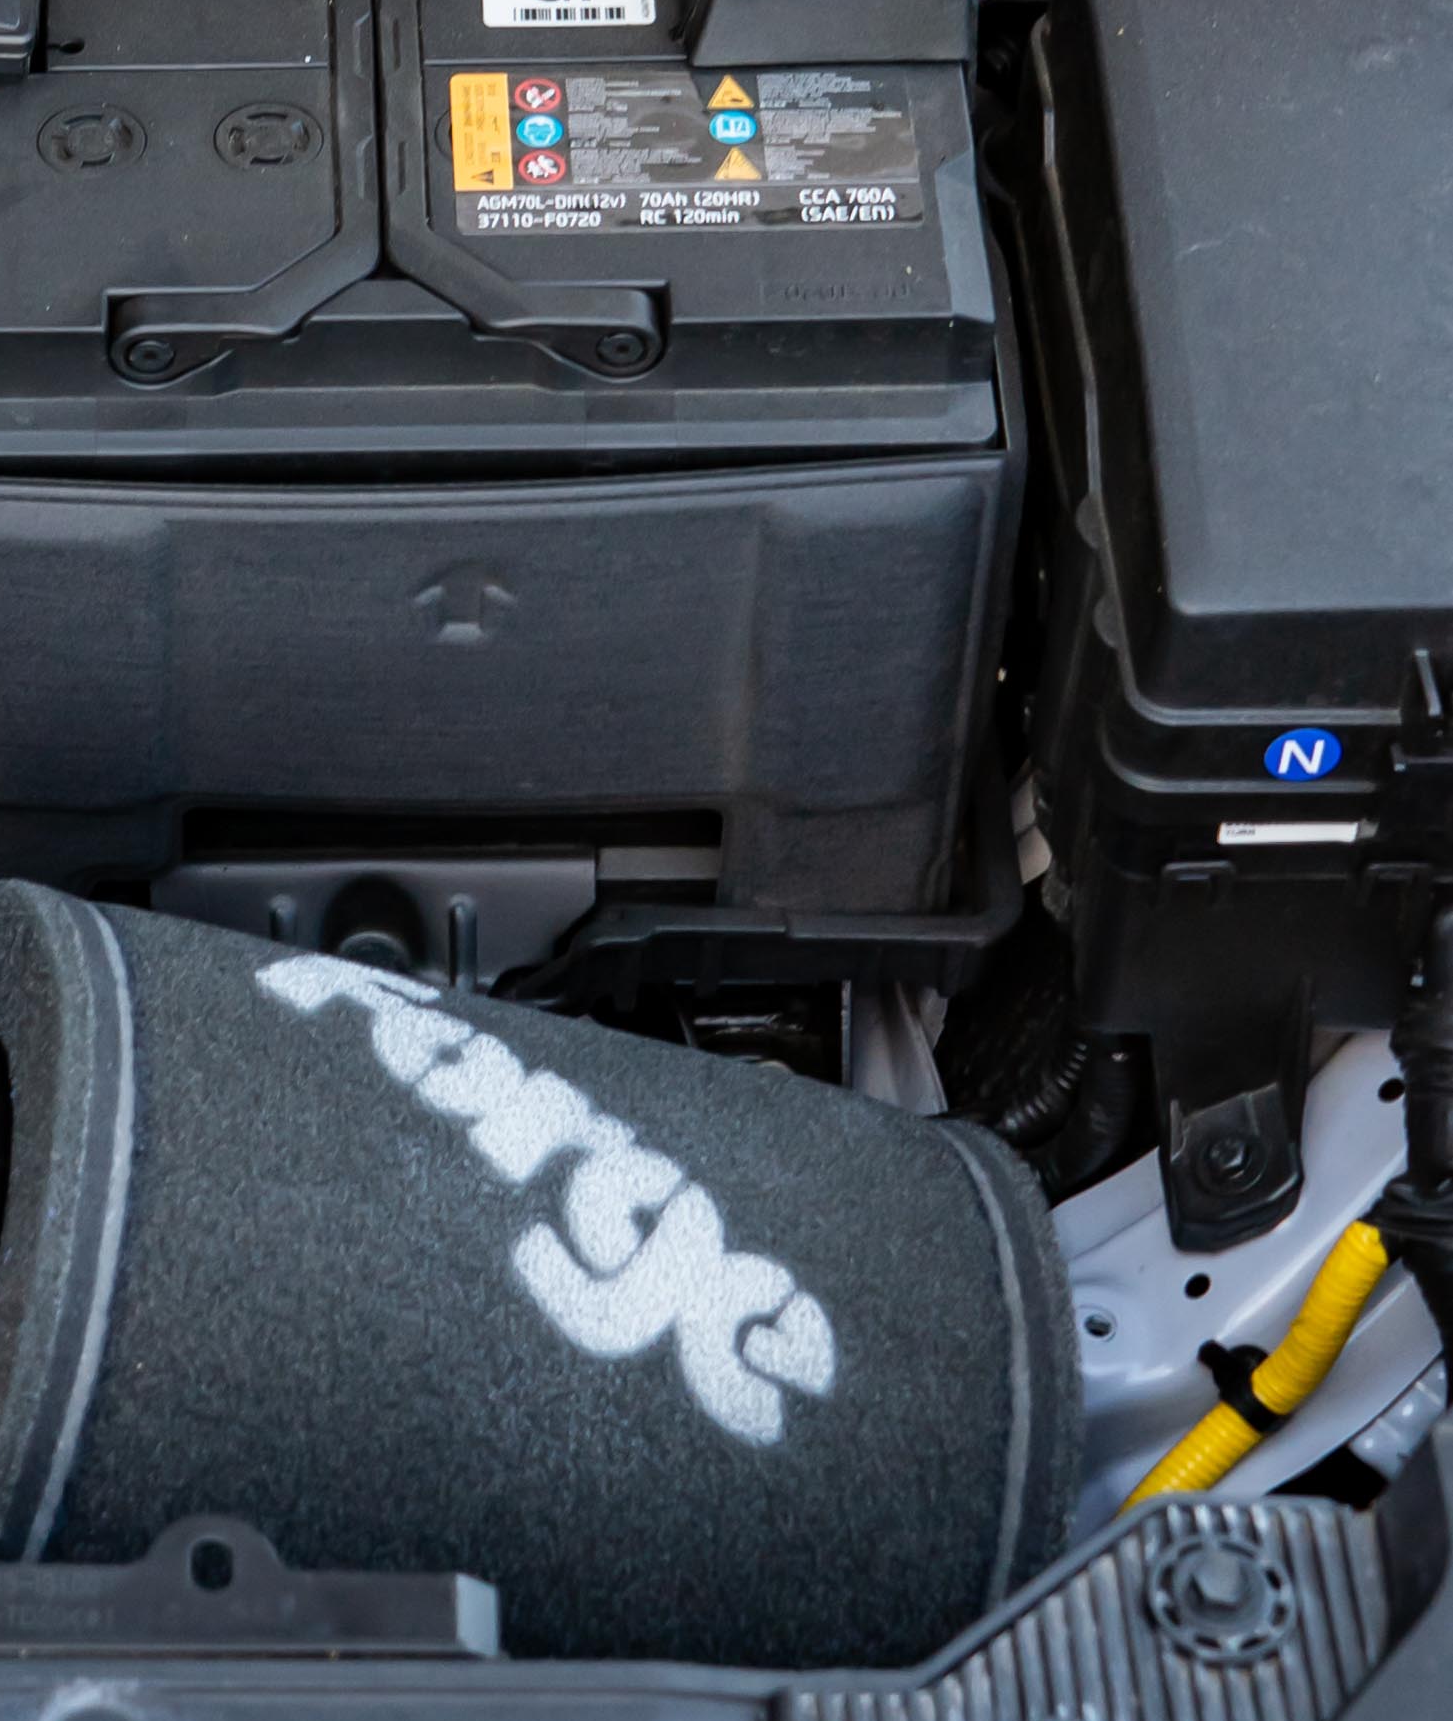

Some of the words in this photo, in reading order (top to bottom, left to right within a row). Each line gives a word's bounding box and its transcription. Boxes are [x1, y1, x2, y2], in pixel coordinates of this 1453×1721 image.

[639, 190, 688, 208] 70Ah
[694, 190, 760, 208] (20HR)
[799, 188, 840, 205] CCA
[639, 208, 666, 226] RC
[674, 208, 740, 225] 120min
[1278, 739, 1324, 775] N
